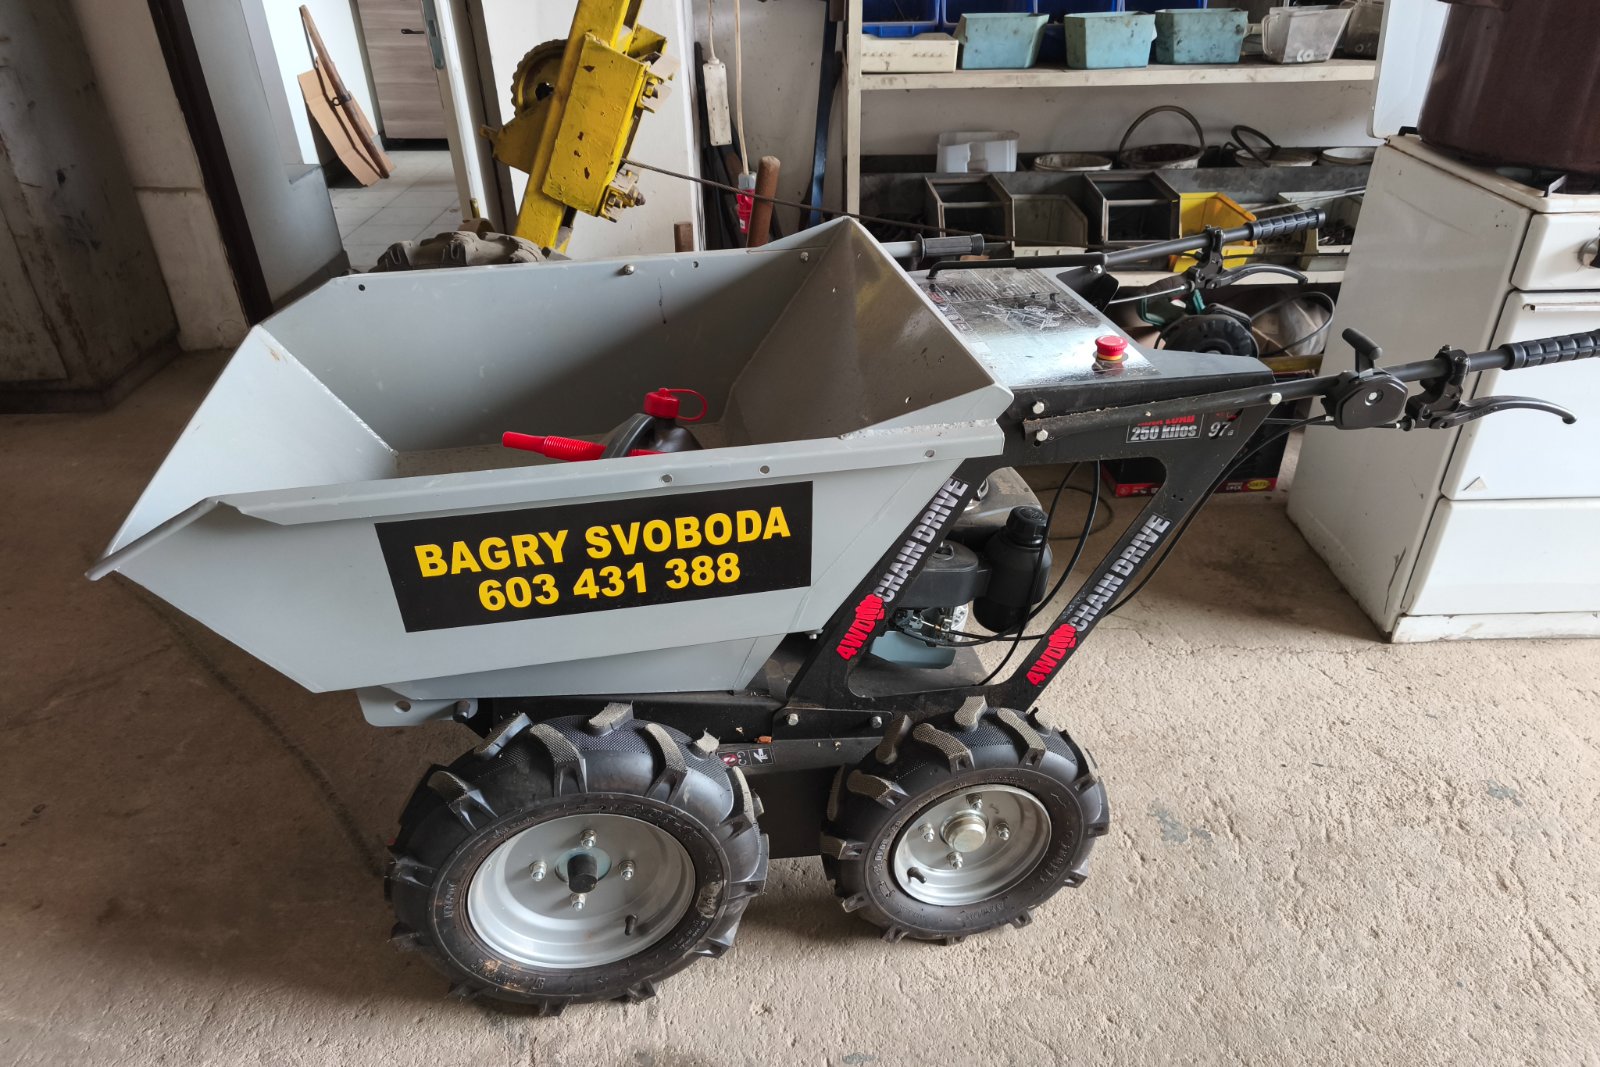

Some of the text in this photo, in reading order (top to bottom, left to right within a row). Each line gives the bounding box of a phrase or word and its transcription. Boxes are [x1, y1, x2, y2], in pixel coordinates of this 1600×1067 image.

[1130, 424, 1198, 441] 250 kilos
[1208, 421, 1231, 437] 97
[414, 507, 791, 578] BAGRY SVOBODA
[836, 477, 969, 661] 4WD CHAIN DRIVE
[478, 552, 741, 611] 603 431 388
[1025, 645, 1068, 687] 4WD
[1067, 572, 1124, 632] CHAIN
[1110, 514, 1171, 577] DRIVE
